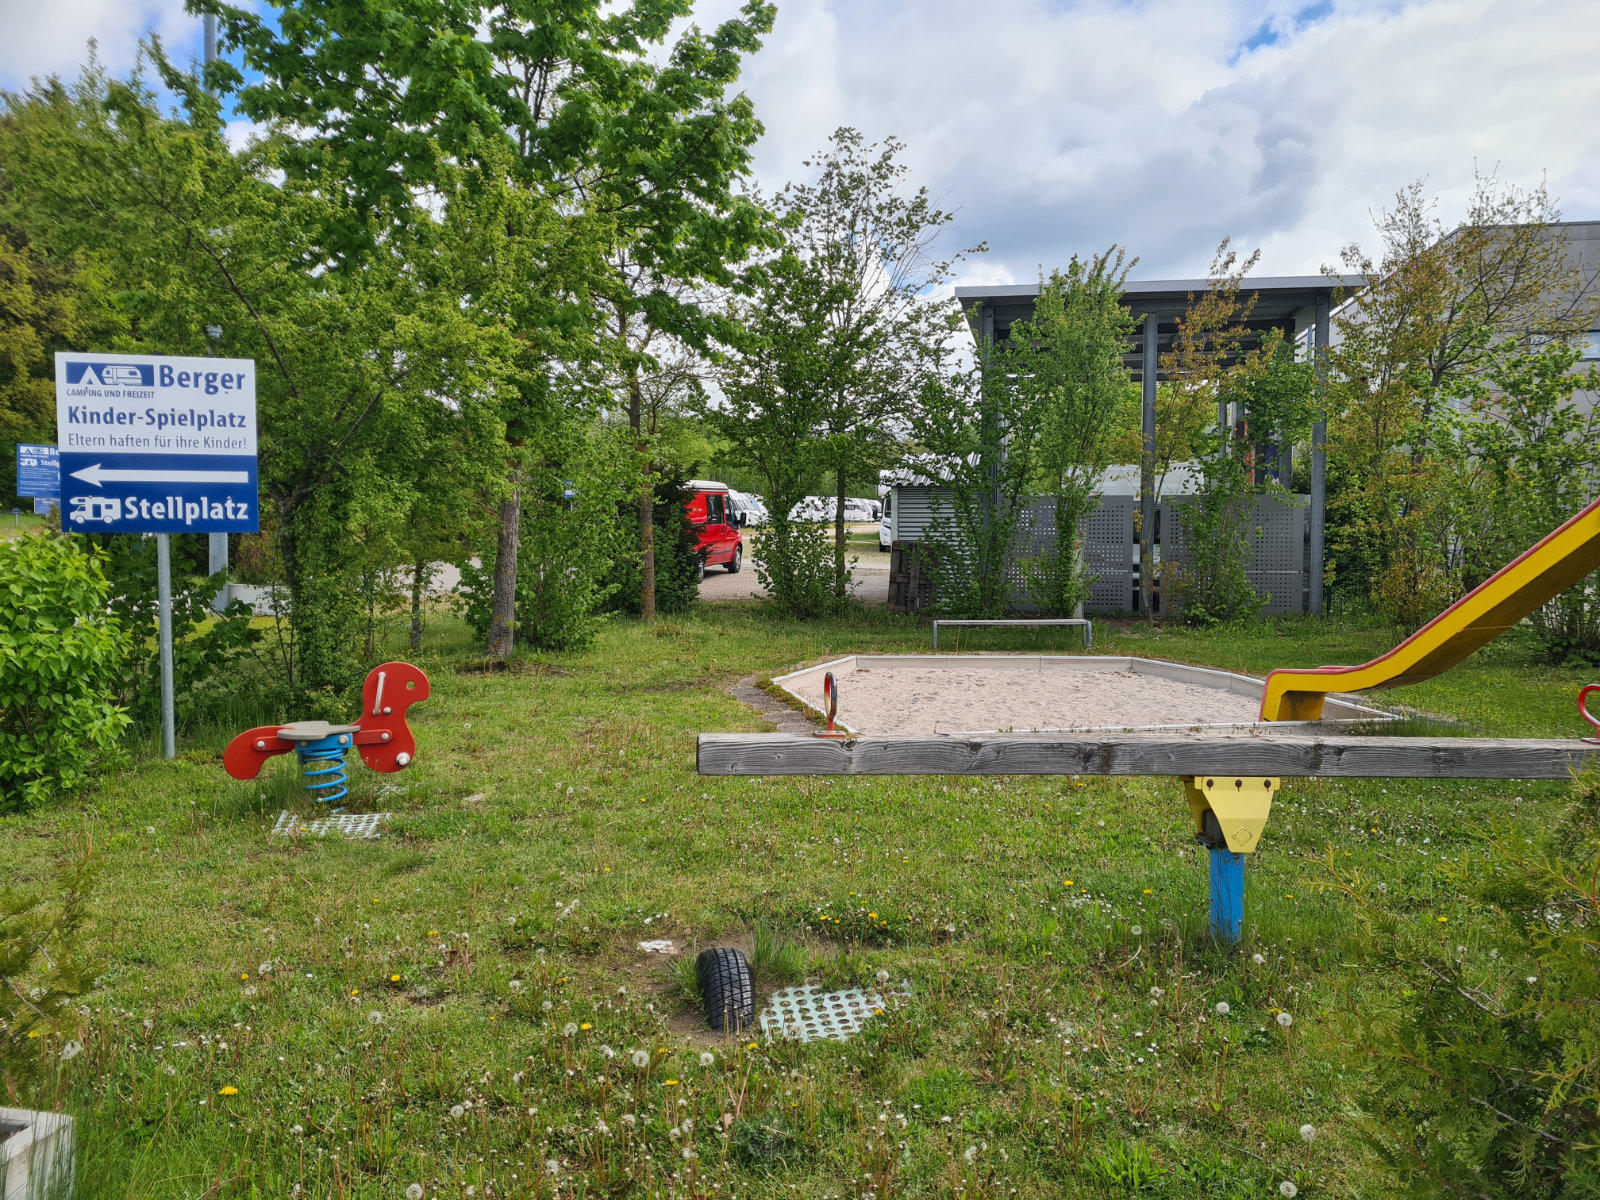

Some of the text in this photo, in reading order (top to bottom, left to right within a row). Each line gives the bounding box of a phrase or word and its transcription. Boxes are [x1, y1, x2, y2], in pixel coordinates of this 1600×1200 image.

[159, 364, 246, 395] Berger
[66, 389, 154, 399] CAMPING UND FREIZEIT
[68, 405, 246, 431] Kinder-Spielplatz
[68, 433, 247, 450] Eltern haften für ihre Kinder!
[124, 496, 249, 526] Stellplatz
